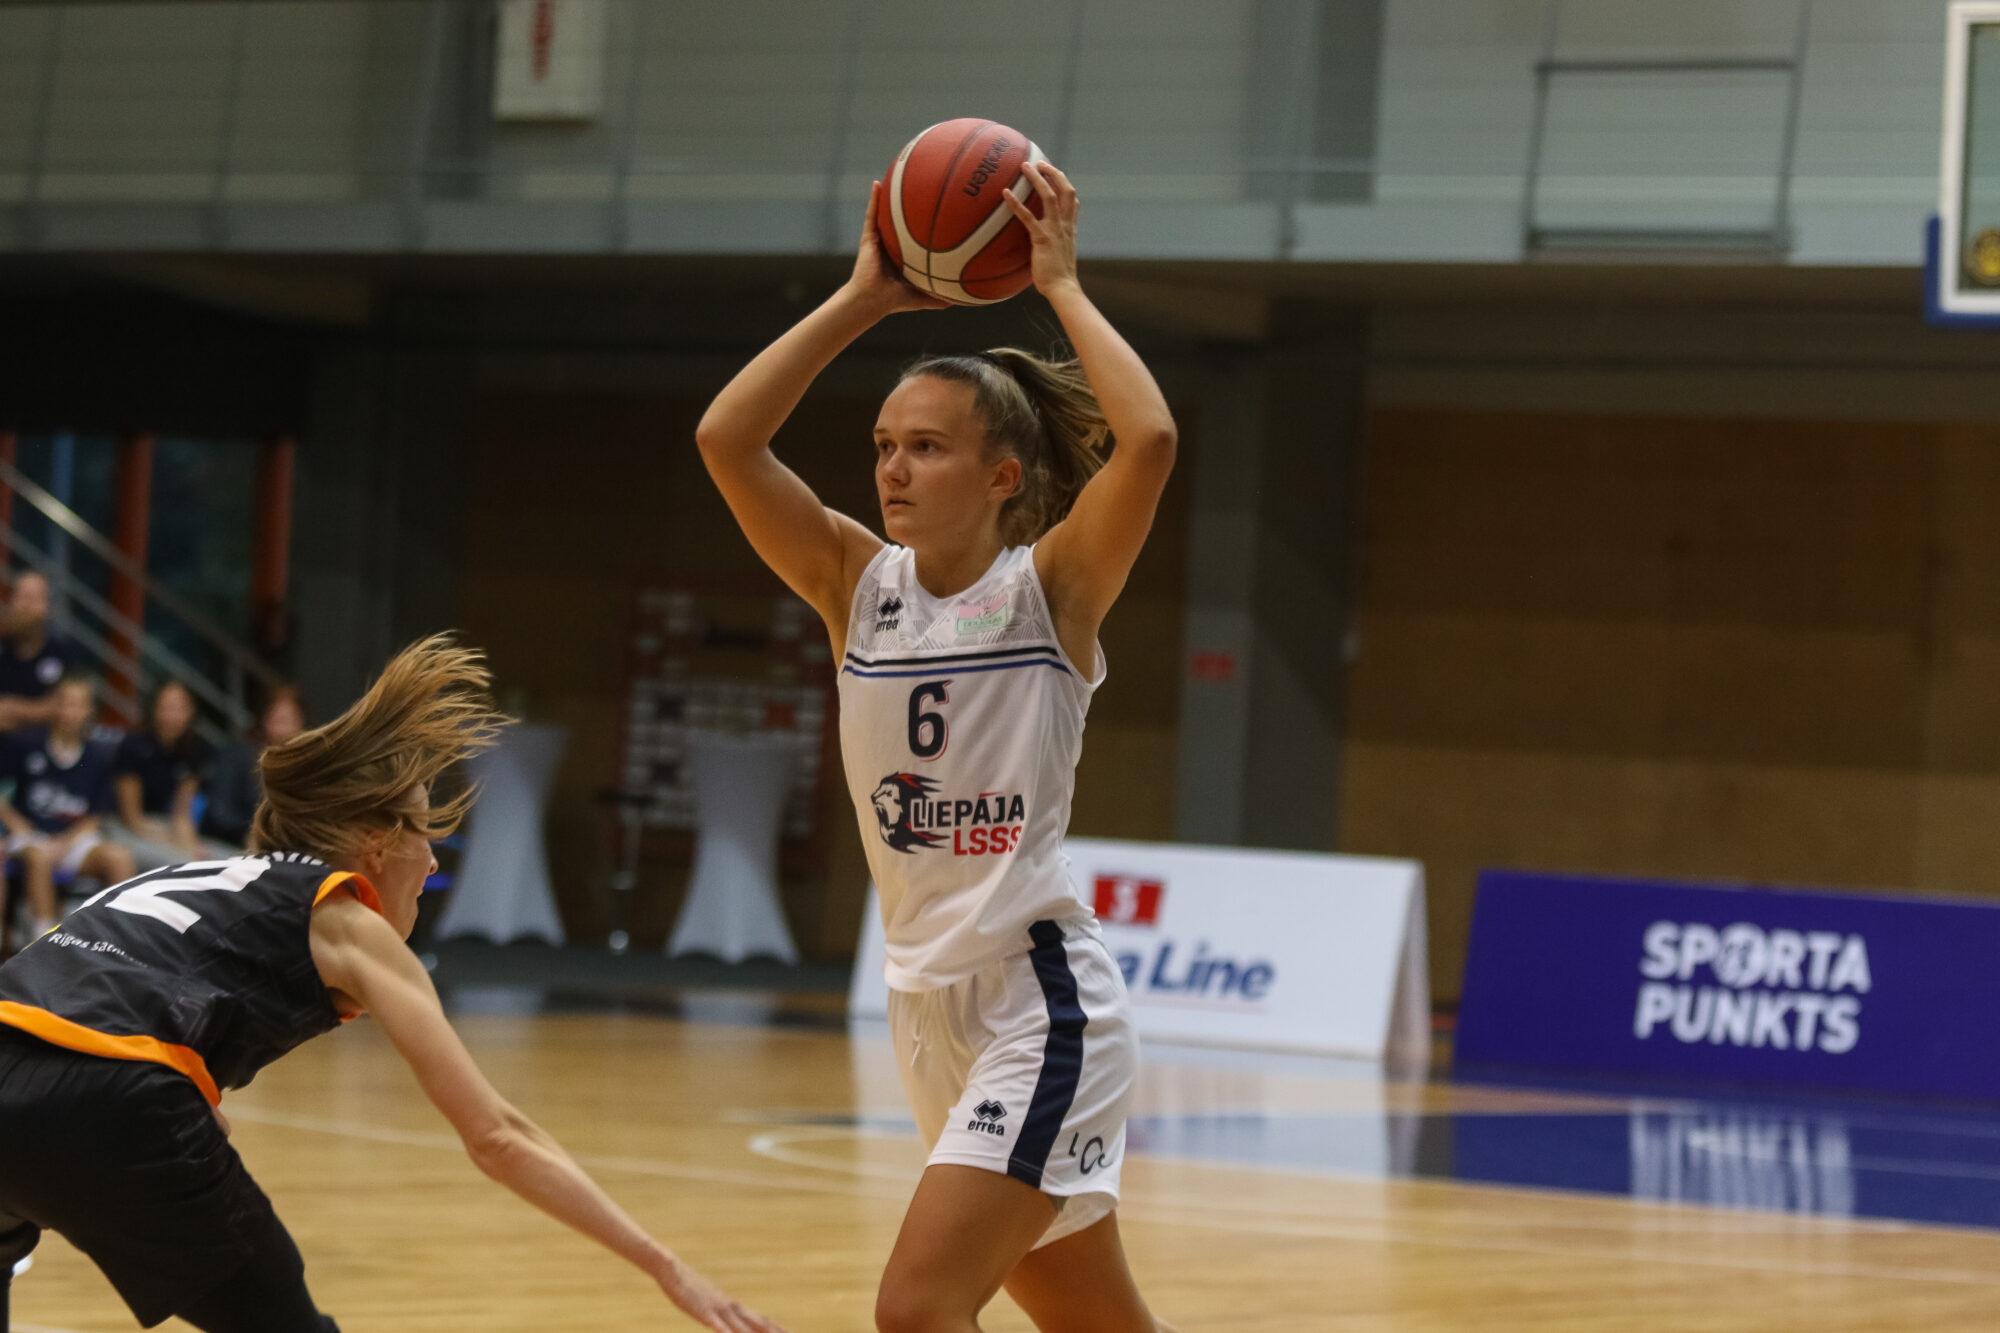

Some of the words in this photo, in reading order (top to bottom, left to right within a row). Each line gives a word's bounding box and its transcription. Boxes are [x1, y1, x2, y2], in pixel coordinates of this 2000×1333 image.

[908, 679, 952, 763] 6
[953, 825, 1022, 857] LSSS
[1149, 939, 1276, 1000] Line
[1639, 920, 1872, 994] SPORTA
[1633, 981, 1861, 1055] PUNKTS
[968, 1119, 1005, 1136] errea
